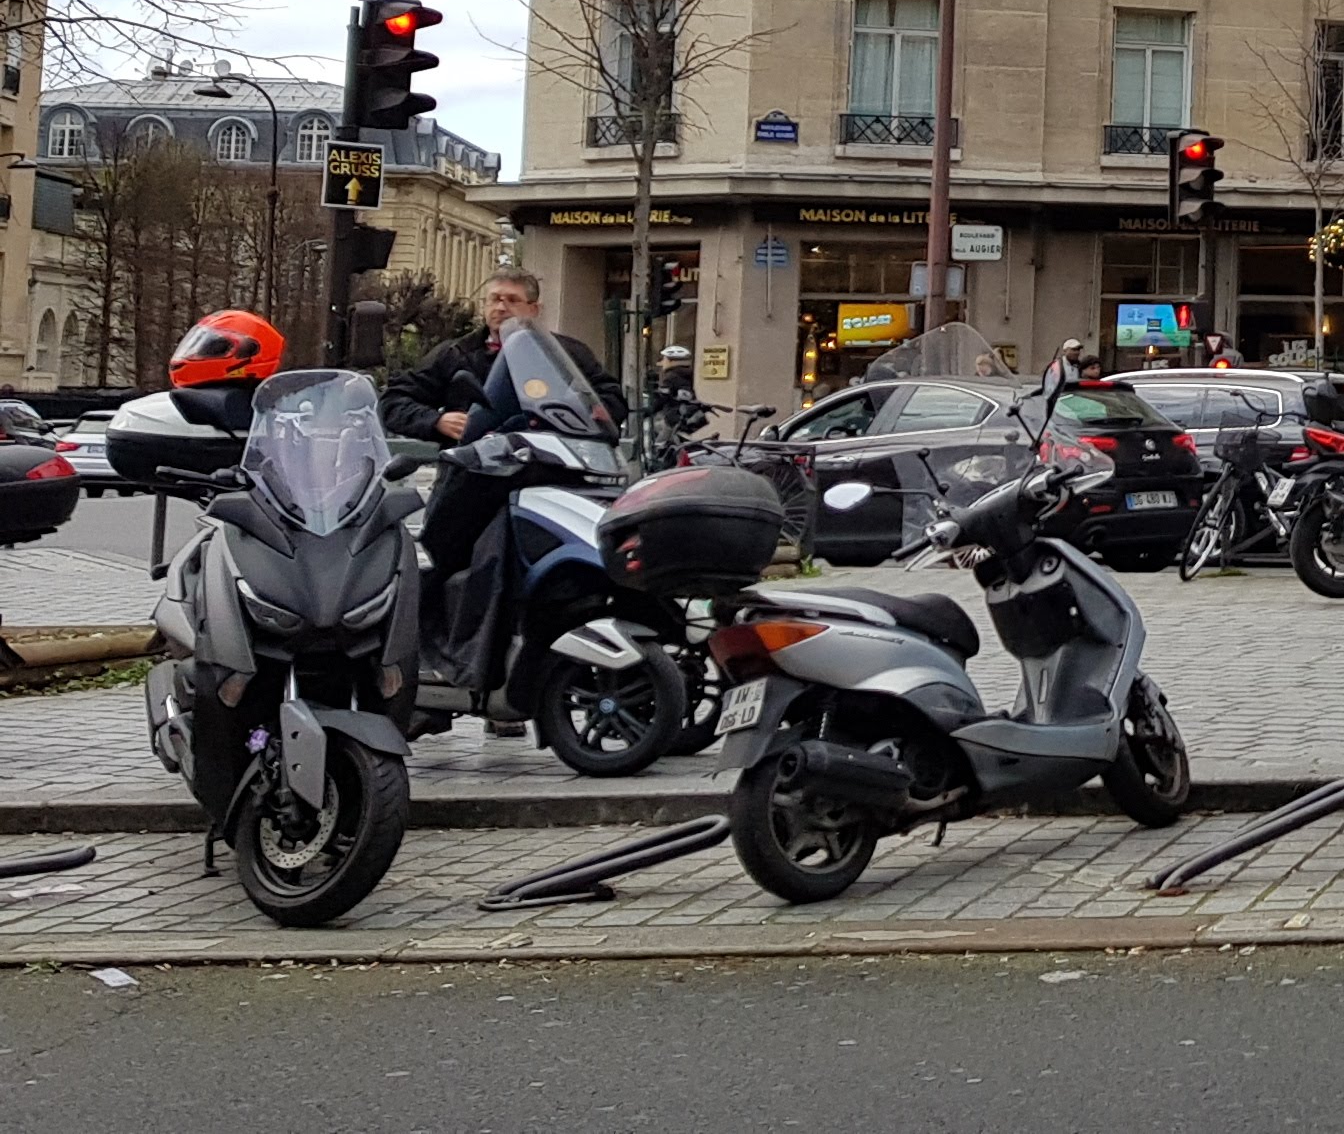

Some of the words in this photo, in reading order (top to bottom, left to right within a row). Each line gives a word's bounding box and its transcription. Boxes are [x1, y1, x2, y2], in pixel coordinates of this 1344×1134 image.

[328, 149, 381, 165] ALEXIS
[329, 162, 379, 178] GRUSS
[550, 211, 600, 224] MAISON
[602, 213, 614, 223] de
[627, 210, 671, 223] LRIE
[800, 209, 866, 222] MAISON
[869, 212, 885, 222] de
[888, 212, 900, 223] la
[903, 212, 957, 225] LITEE
[1119, 218, 1177, 230] MAISO
